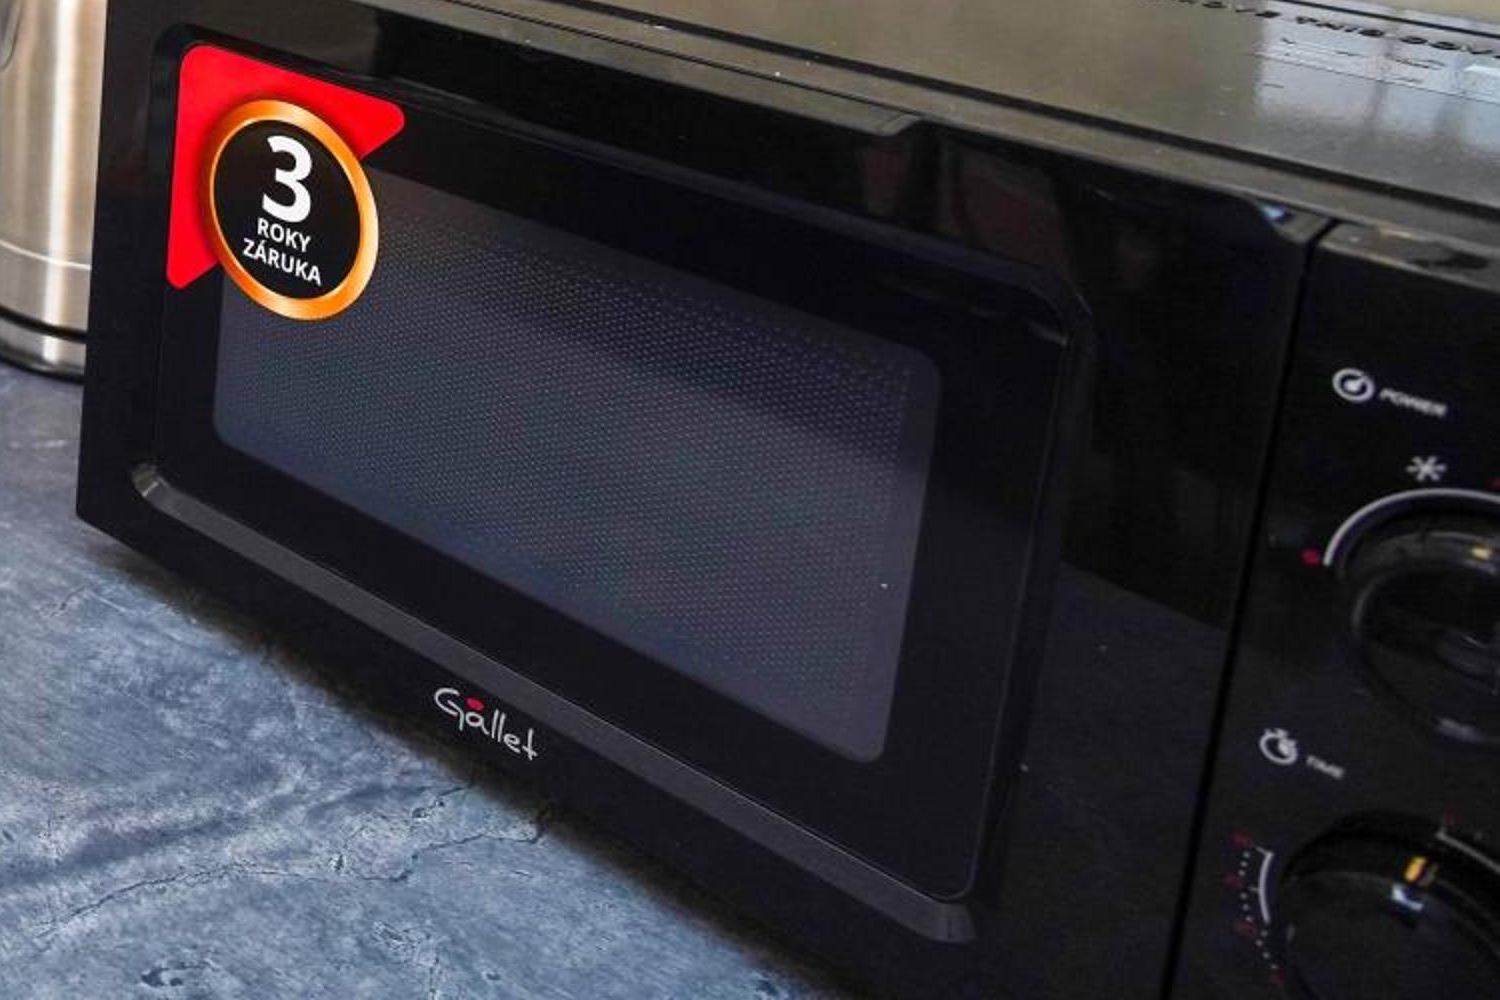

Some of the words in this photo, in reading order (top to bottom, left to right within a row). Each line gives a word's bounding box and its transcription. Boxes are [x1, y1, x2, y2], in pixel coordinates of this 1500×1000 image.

[261, 134, 312, 223] 3
[243, 236, 322, 286] ZÁRUKA
[257, 217, 311, 252] ROKY
[434, 687, 538, 761] Gallet
